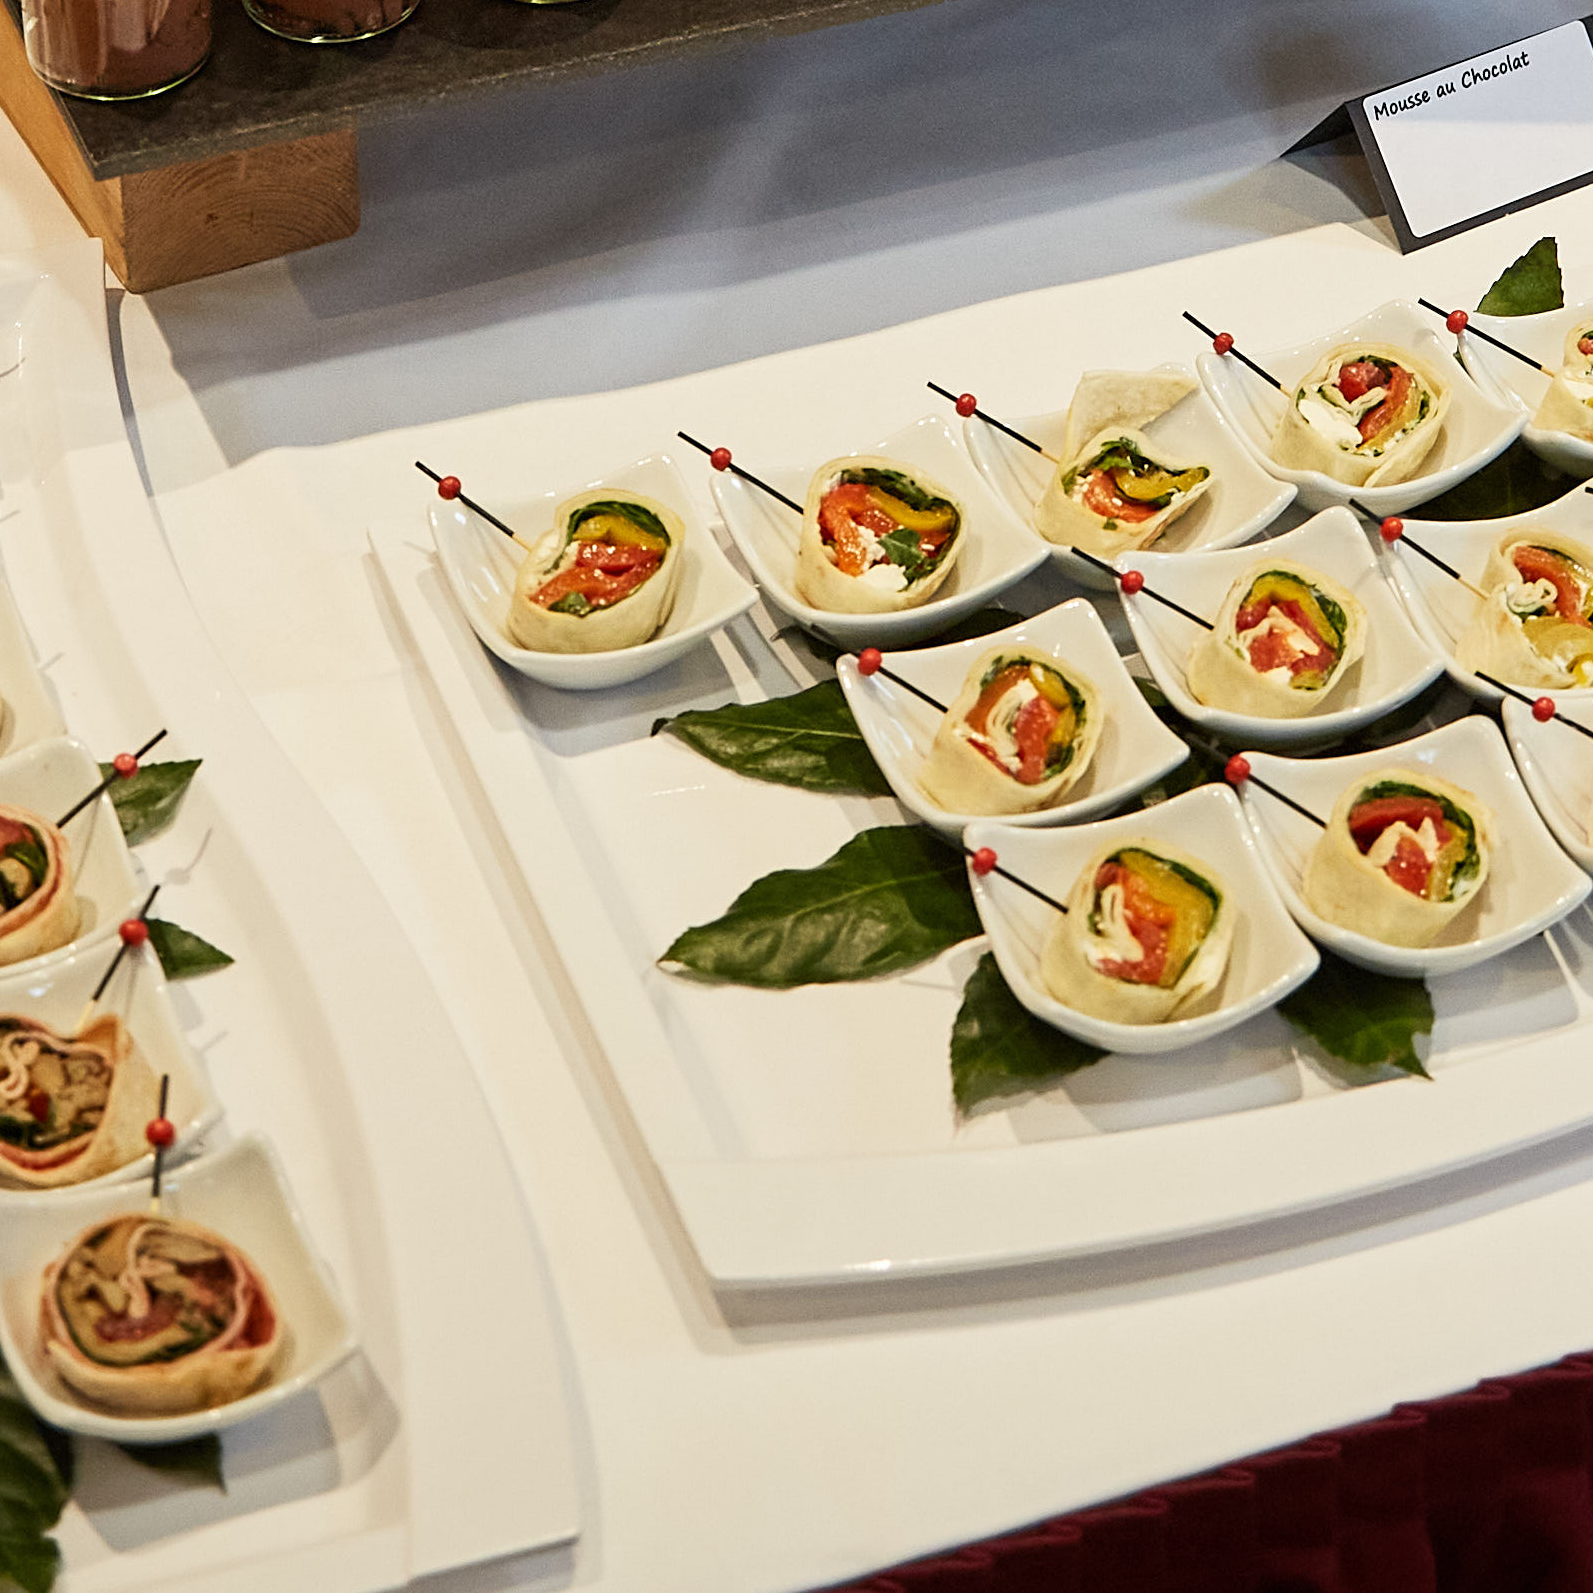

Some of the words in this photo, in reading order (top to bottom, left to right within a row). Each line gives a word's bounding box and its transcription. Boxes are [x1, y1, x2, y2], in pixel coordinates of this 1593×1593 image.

[1373, 88, 1431, 121] Mousse
[1436, 80, 1457, 100] au
[1461, 50, 1531, 90] Chocolat
